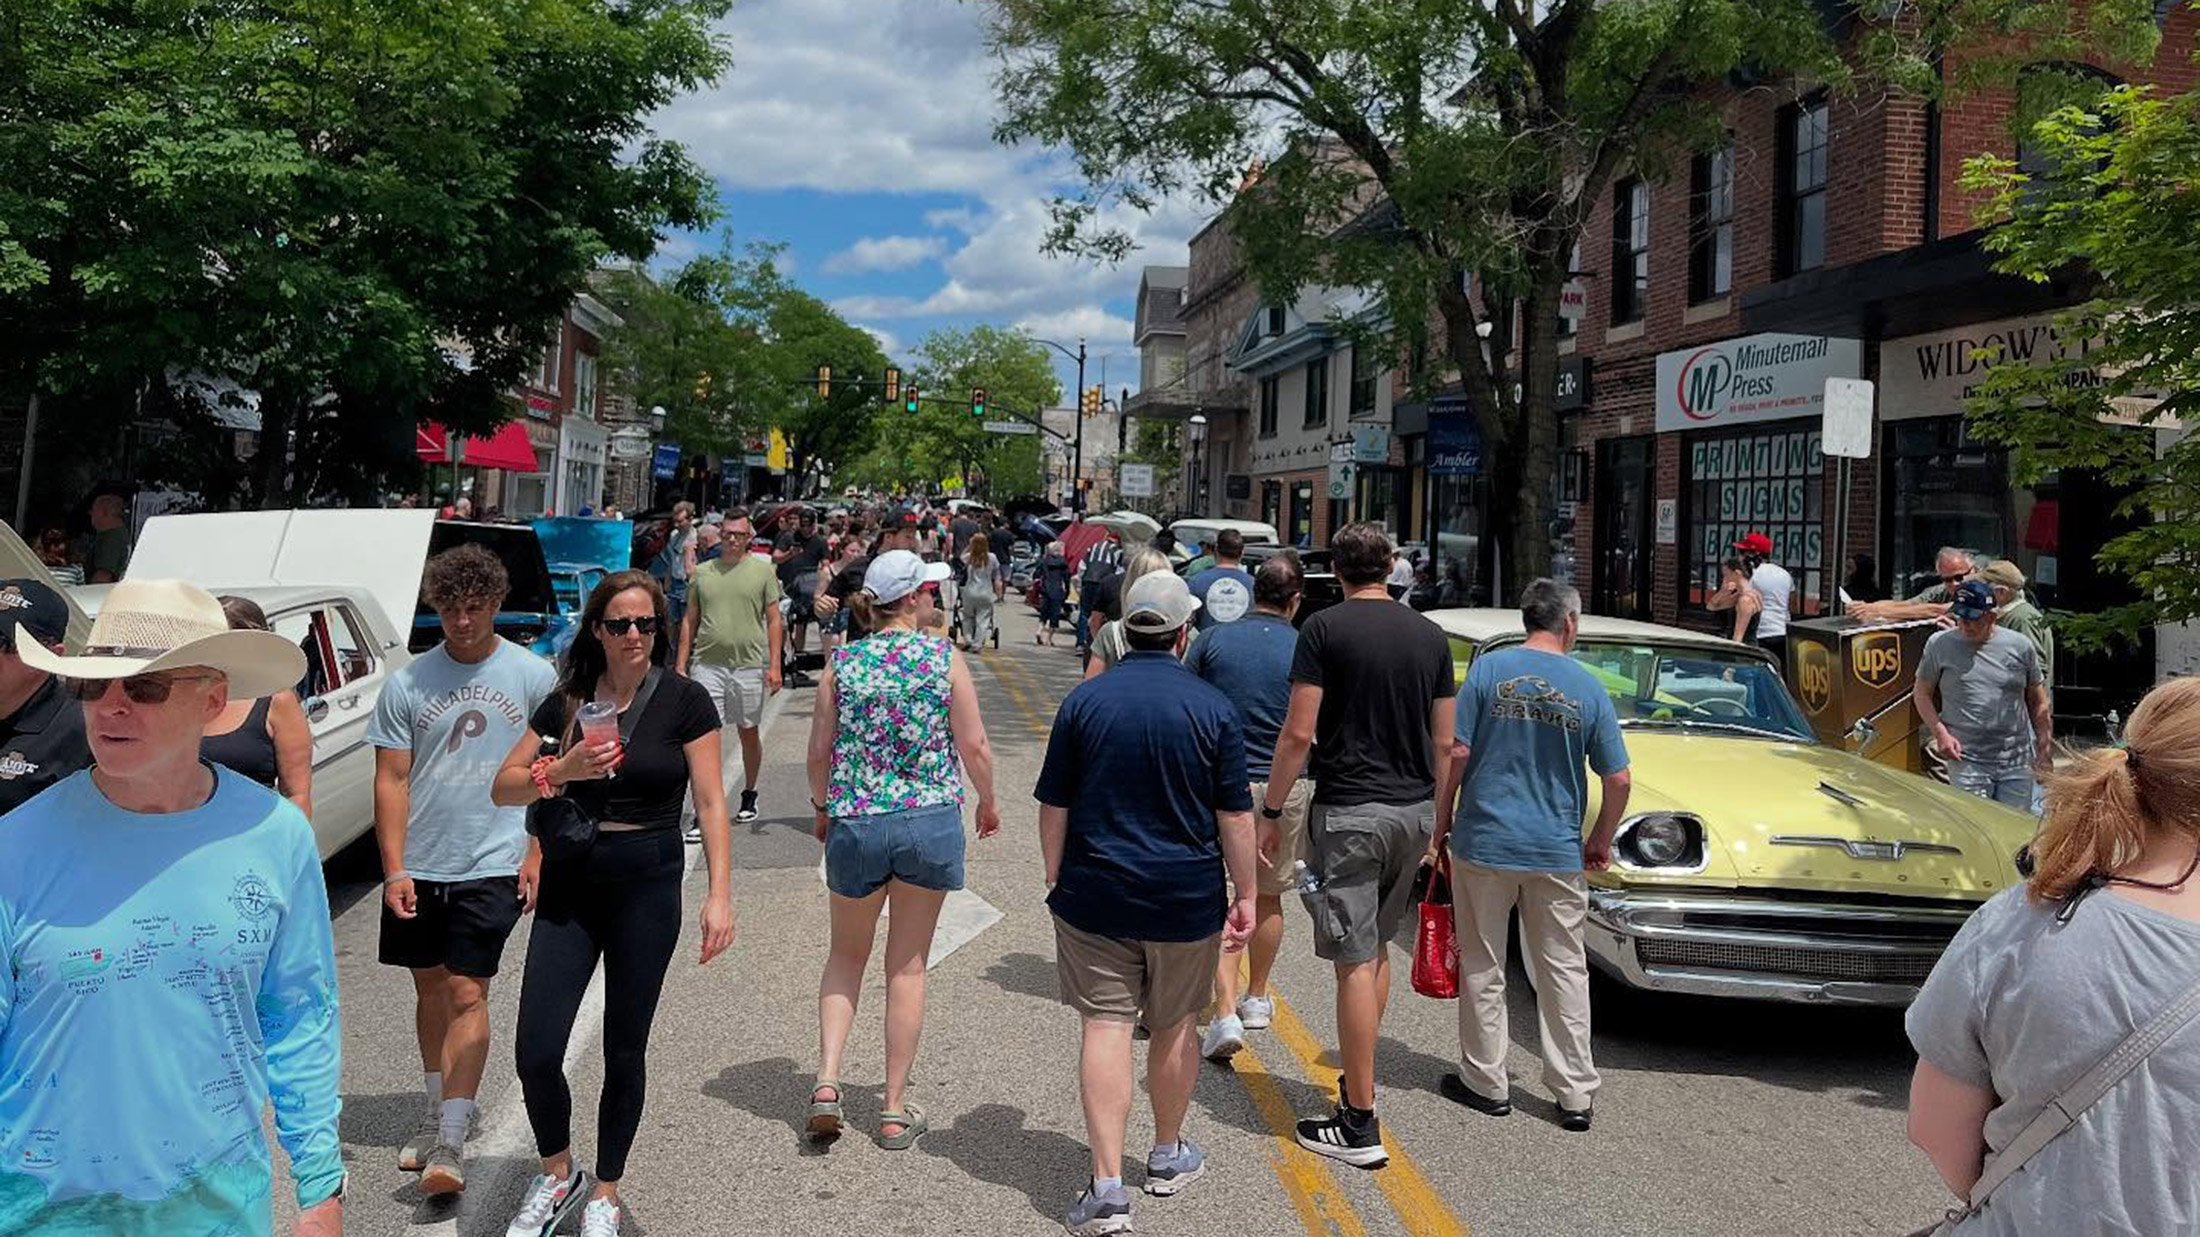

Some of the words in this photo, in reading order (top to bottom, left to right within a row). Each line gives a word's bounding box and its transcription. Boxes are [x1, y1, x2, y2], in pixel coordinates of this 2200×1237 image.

[1735, 337, 1828, 372] Minuteman
[1731, 374, 1774, 399] Press
[1431, 451, 1479, 468] Ambler
[1694, 438, 1822, 473] PRINTING
[1723, 485, 1802, 515] SIGNS
[1707, 529, 1821, 561] BAERS
[1857, 648, 1898, 680] ups
[1802, 662, 1828, 703] ups
[417, 685, 522, 732] PHILADELPHIA
